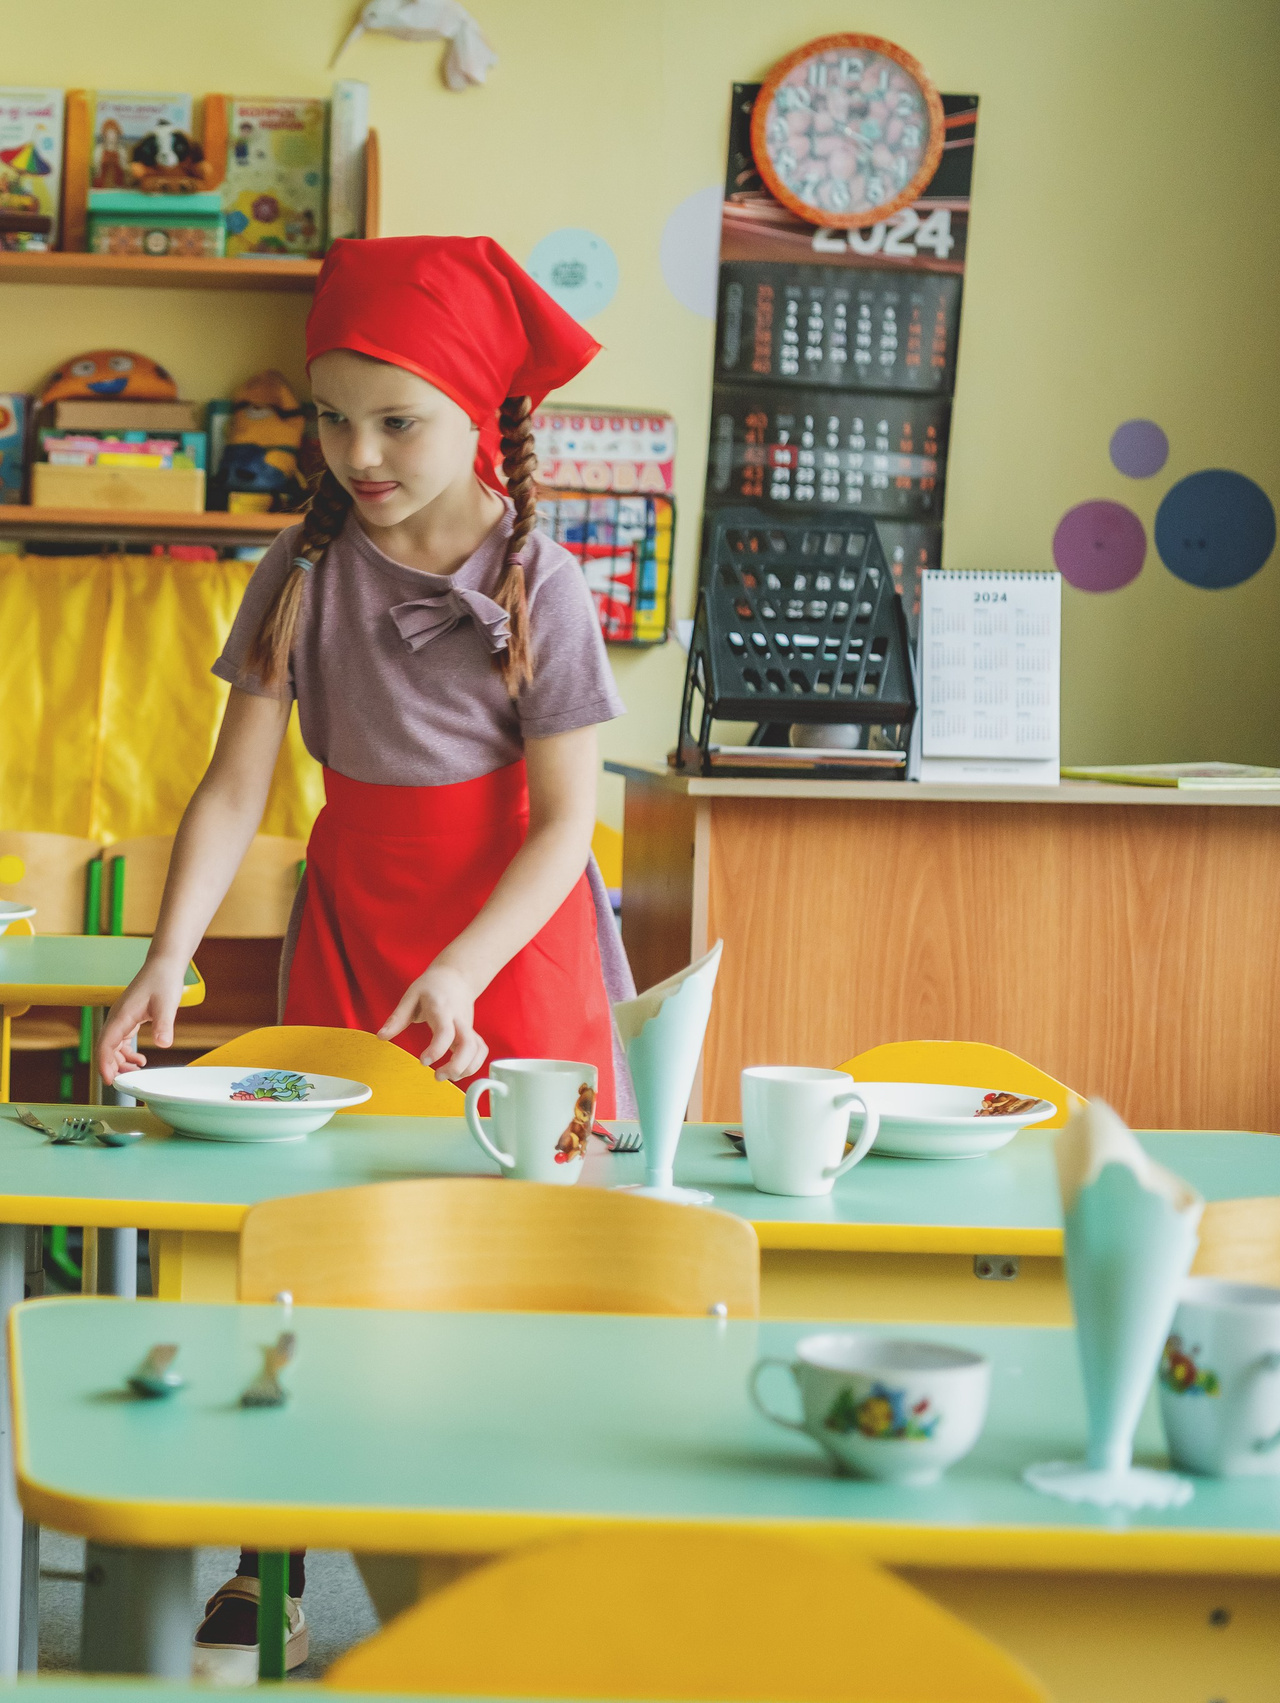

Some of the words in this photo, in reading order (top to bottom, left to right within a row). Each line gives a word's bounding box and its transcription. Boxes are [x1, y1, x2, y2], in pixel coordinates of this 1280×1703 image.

[809, 64, 827, 87] 11
[841, 57, 864, 81] 12
[879, 69, 889, 90] 1
[897, 92, 914, 116] 2
[866, 176, 885, 203] 5
[973, 592, 1008, 602] 2024
